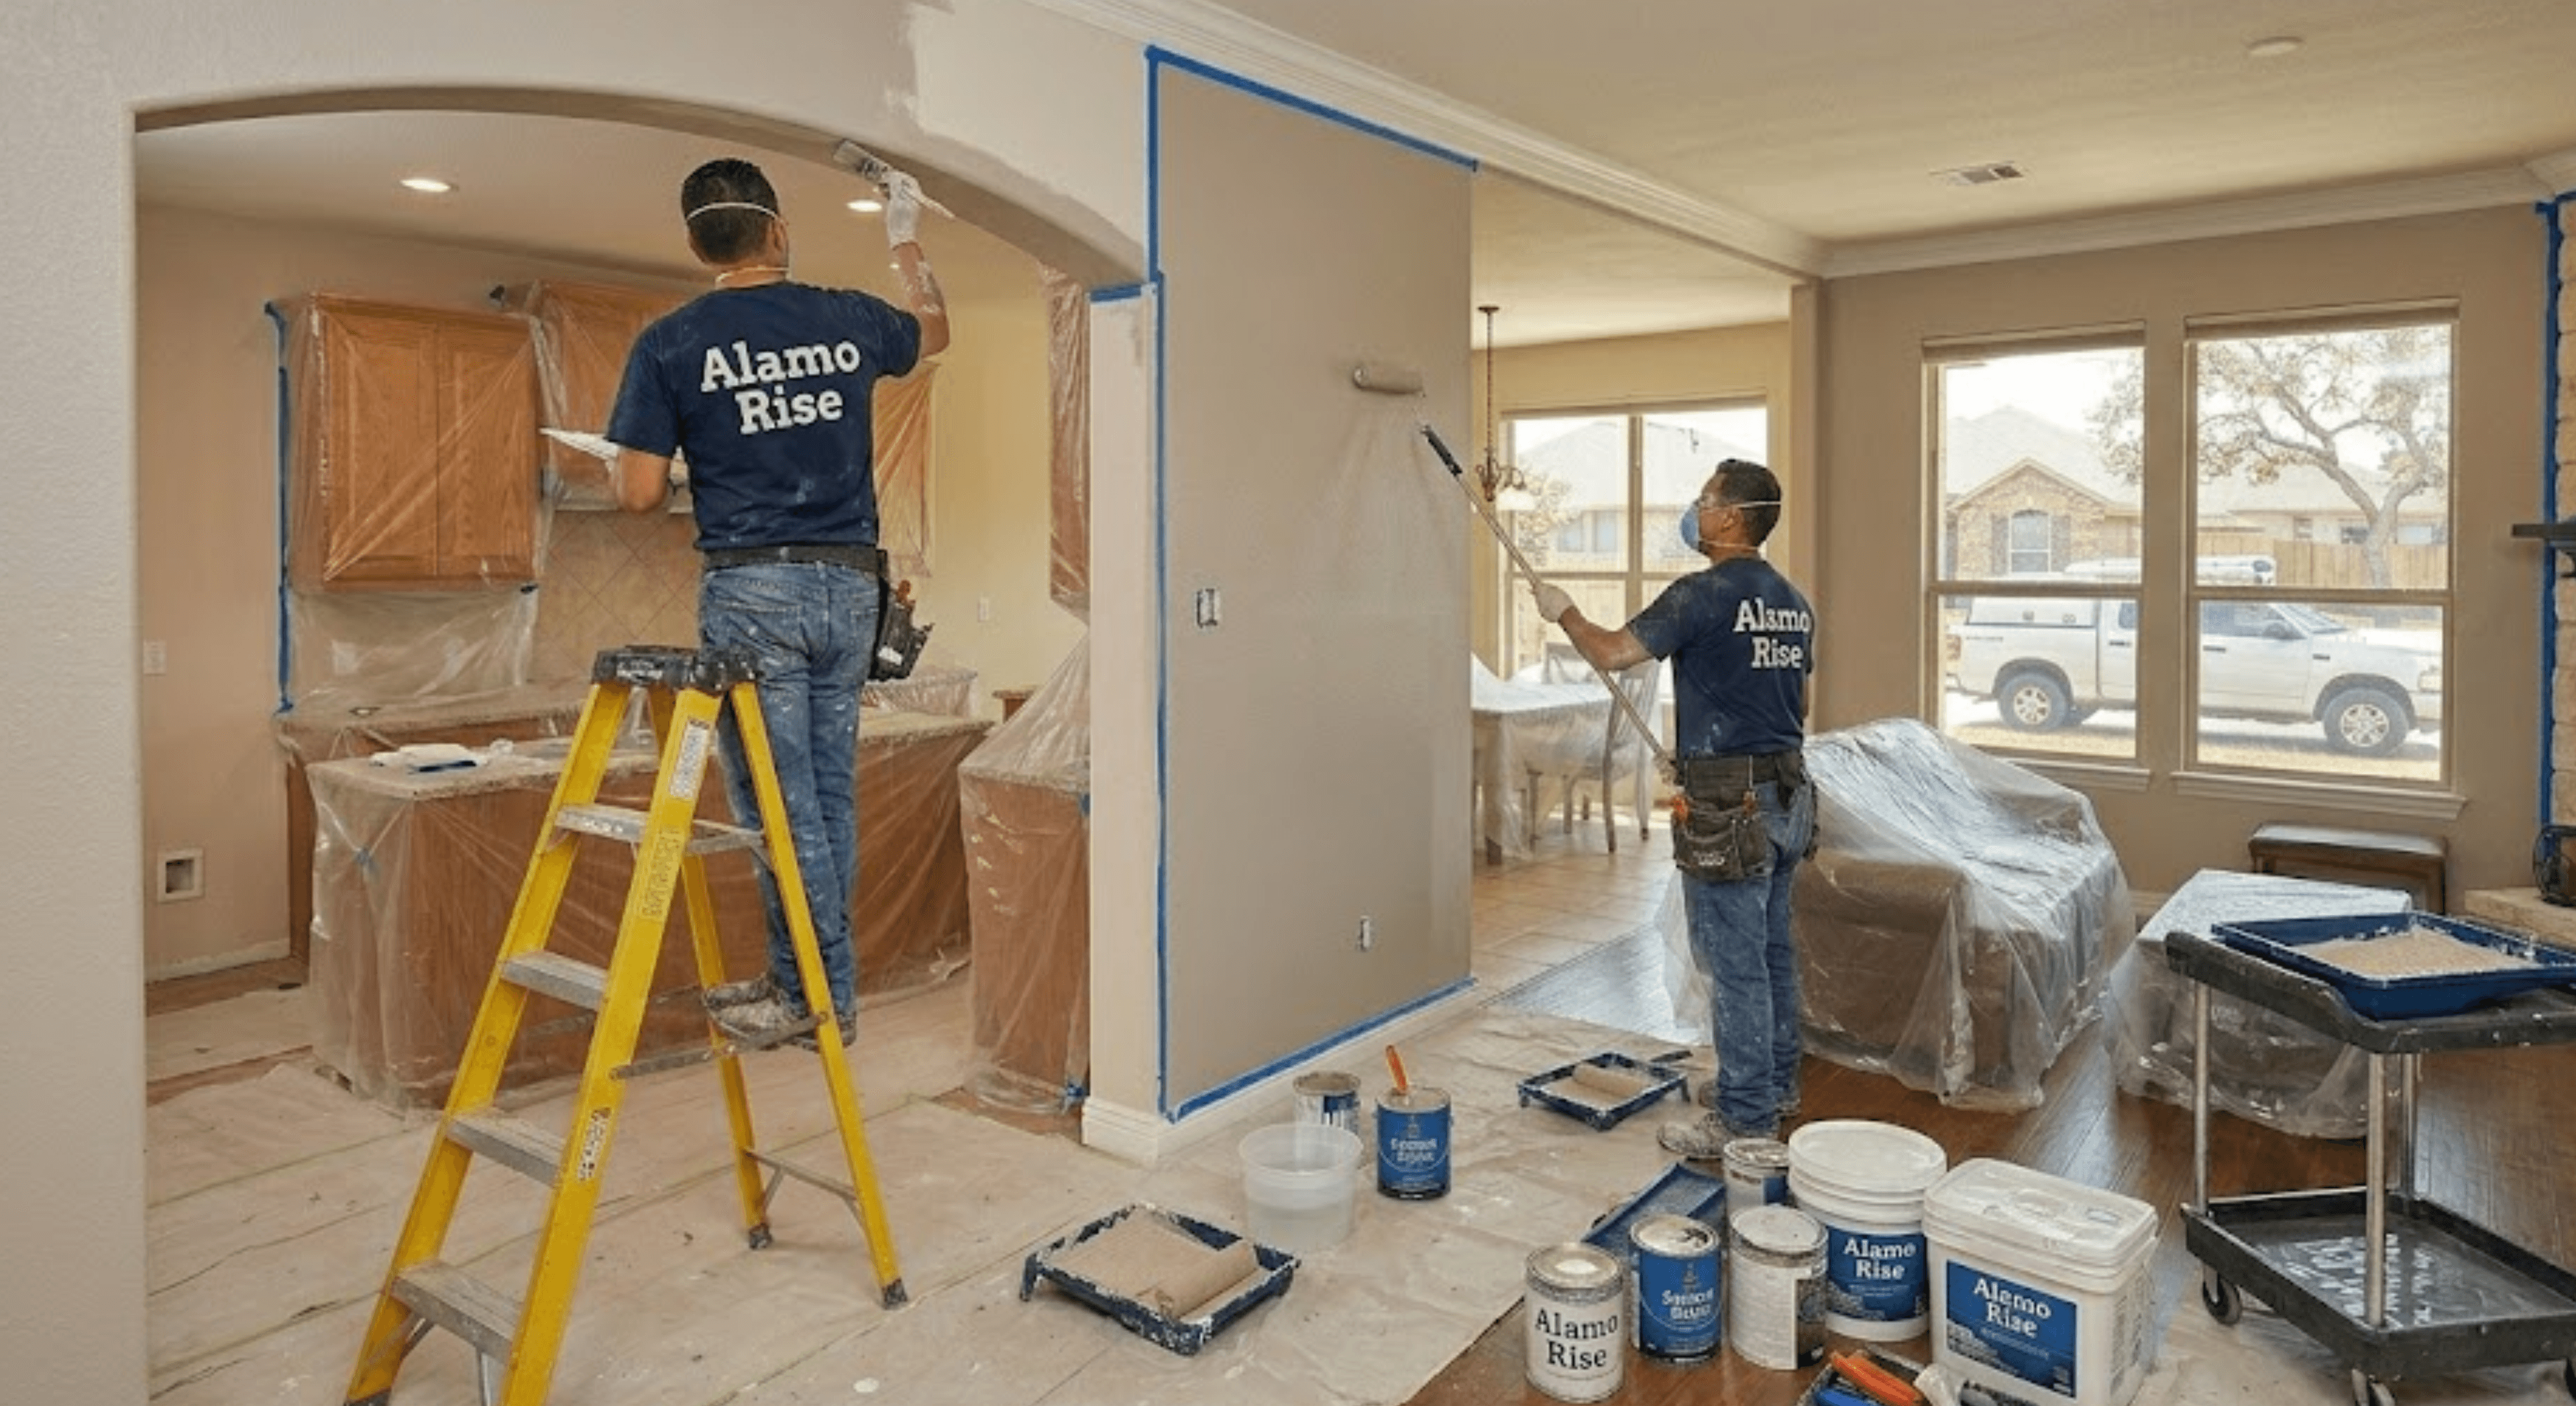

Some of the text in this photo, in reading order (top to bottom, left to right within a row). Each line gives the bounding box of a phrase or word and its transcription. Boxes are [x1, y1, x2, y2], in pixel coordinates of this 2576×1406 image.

[700, 339, 861, 393] Alamo
[735, 384, 843, 435] Rise
[1731, 596, 1811, 634] Alamo
[1752, 637, 1803, 669] Rise
[1842, 1236, 1917, 1260] Alamo
[1856, 1258, 1904, 1280] Rise
[1535, 1307, 1618, 1340] Alamo
[1546, 1339, 1607, 1370] Rise
